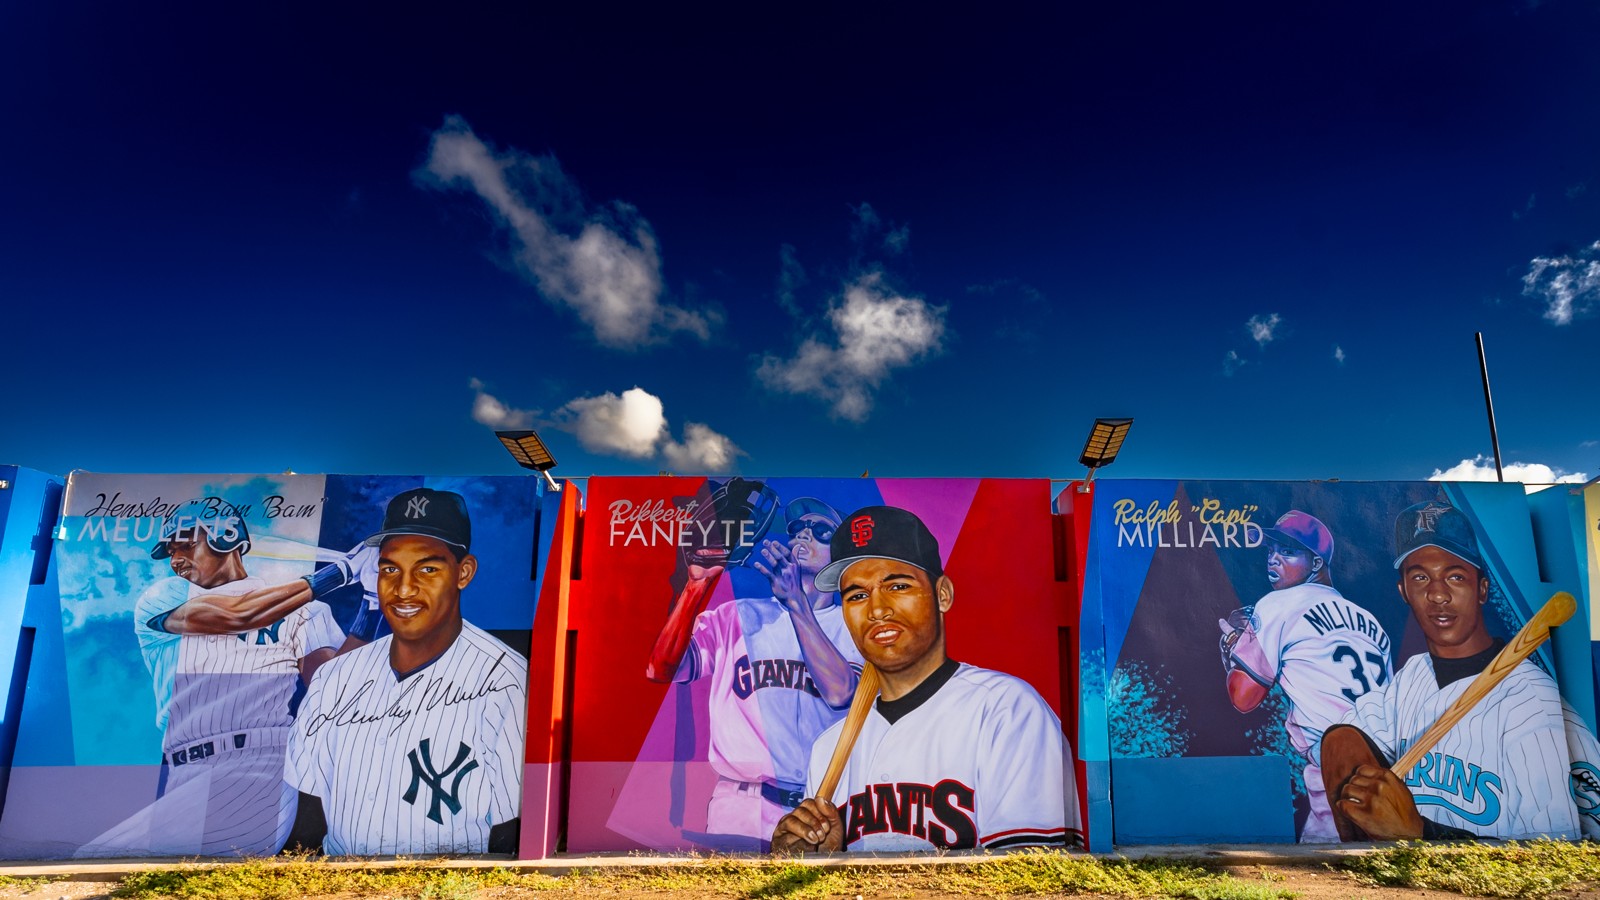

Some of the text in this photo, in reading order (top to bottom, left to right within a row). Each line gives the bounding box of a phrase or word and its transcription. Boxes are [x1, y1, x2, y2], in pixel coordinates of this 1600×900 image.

[84, 492, 180, 525] Hensley
[404, 495, 430, 519] NY
[608, 498, 699, 525] Rikkert
[1113, 498, 1182, 532] Ralph
[77, 515, 240, 543] MEULENS
[609, 519, 755, 547] FANEYTE
[1117, 521, 1264, 548] MILLIARD
[1303, 600, 1390, 653] MILLIARD
[1332, 645, 1387, 703] 37
[402, 737, 479, 826] NY
